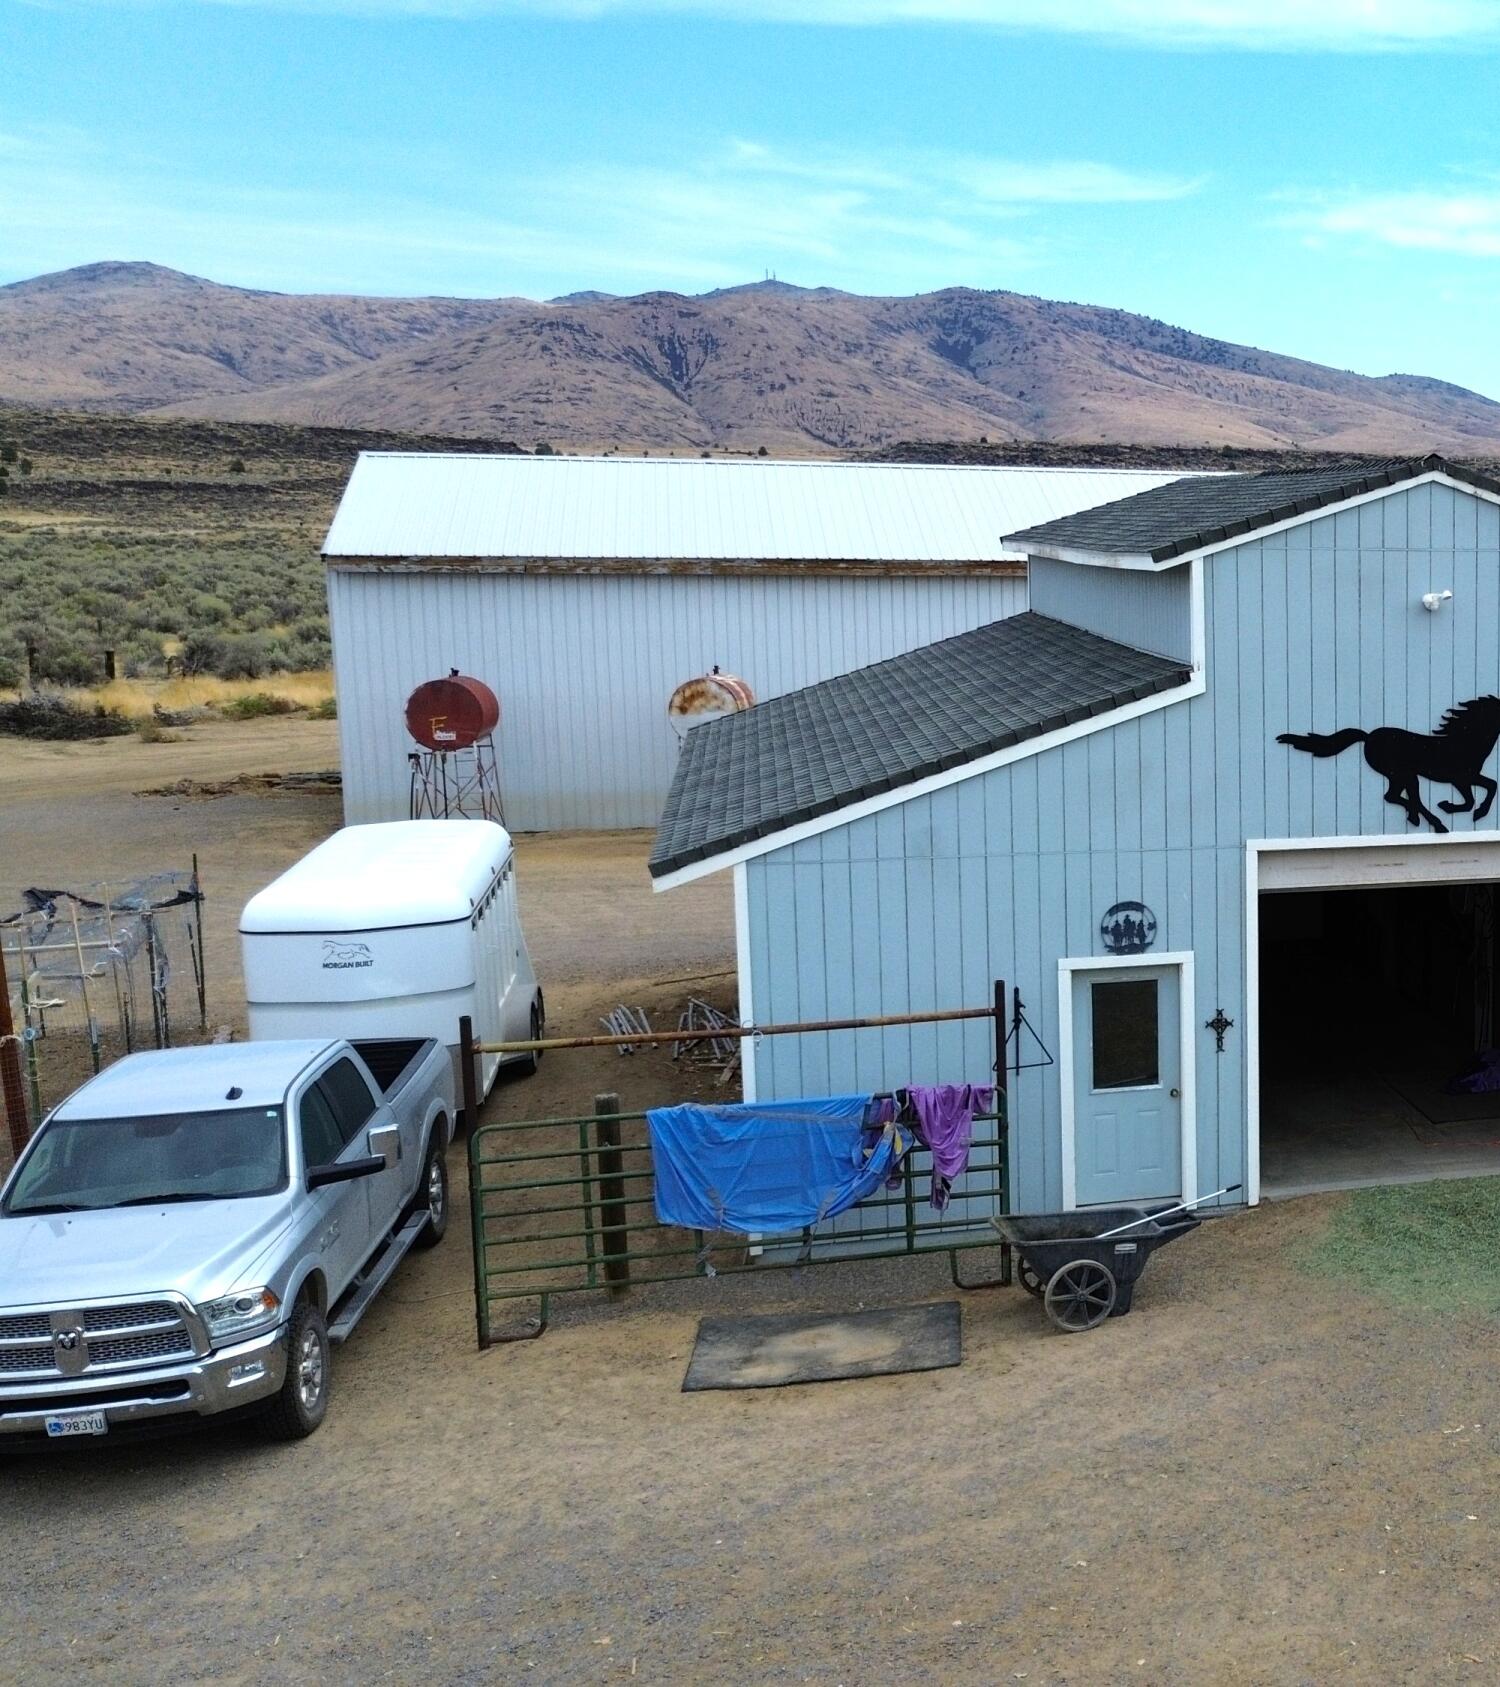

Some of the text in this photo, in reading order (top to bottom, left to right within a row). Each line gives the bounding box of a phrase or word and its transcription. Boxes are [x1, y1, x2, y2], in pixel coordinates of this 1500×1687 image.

[322, 959, 374, 969] MORGAN BUILT
[64, 1417, 103, 1432] 983YU
